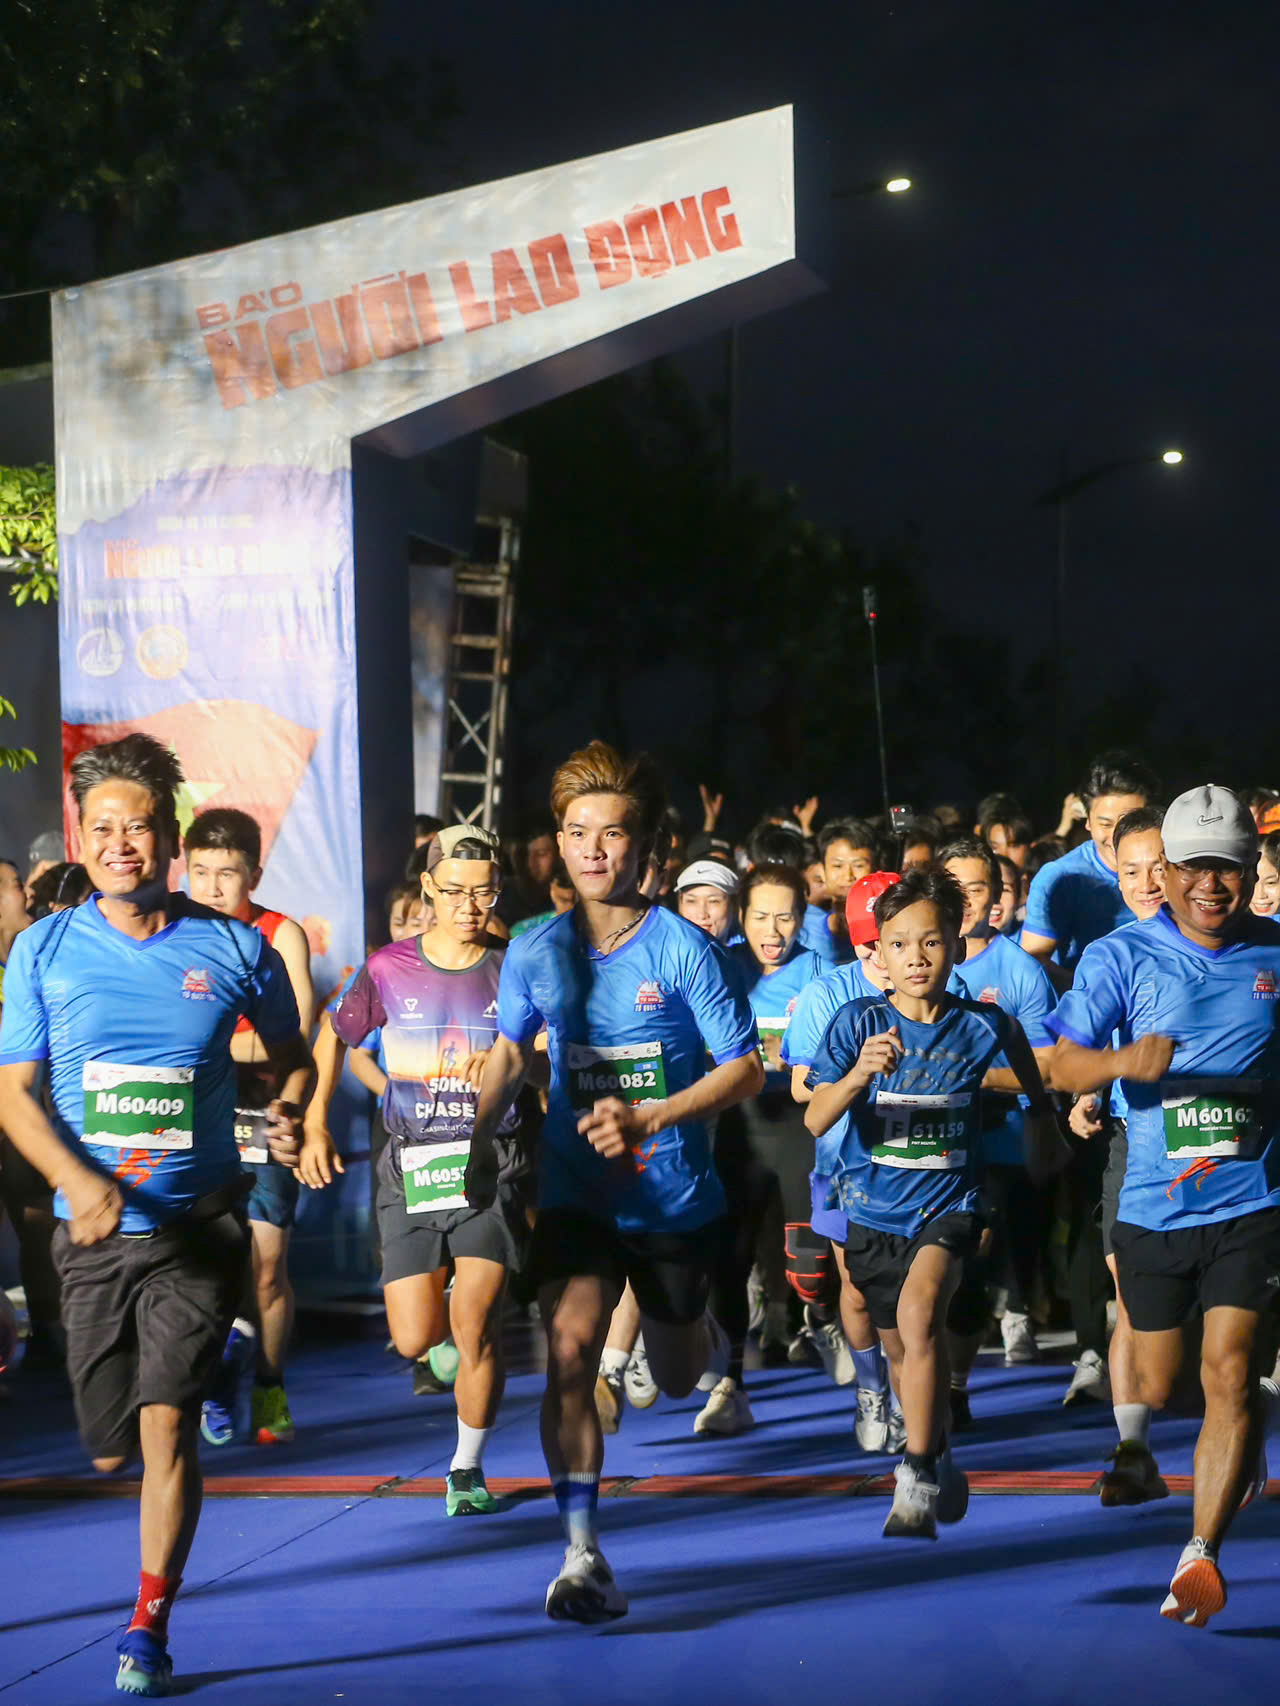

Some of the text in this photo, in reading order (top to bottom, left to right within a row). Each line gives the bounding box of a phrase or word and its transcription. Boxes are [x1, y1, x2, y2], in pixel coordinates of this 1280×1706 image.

[196, 281, 303, 329] BÁO
[203, 186, 743, 410] NGƯỜI LAO ĐỘNG
[578, 1071, 657, 1091] M60082
[95, 1092, 185, 1116] M60409
[415, 1102, 475, 1119] CHASE
[912, 1121, 965, 1139] 61159
